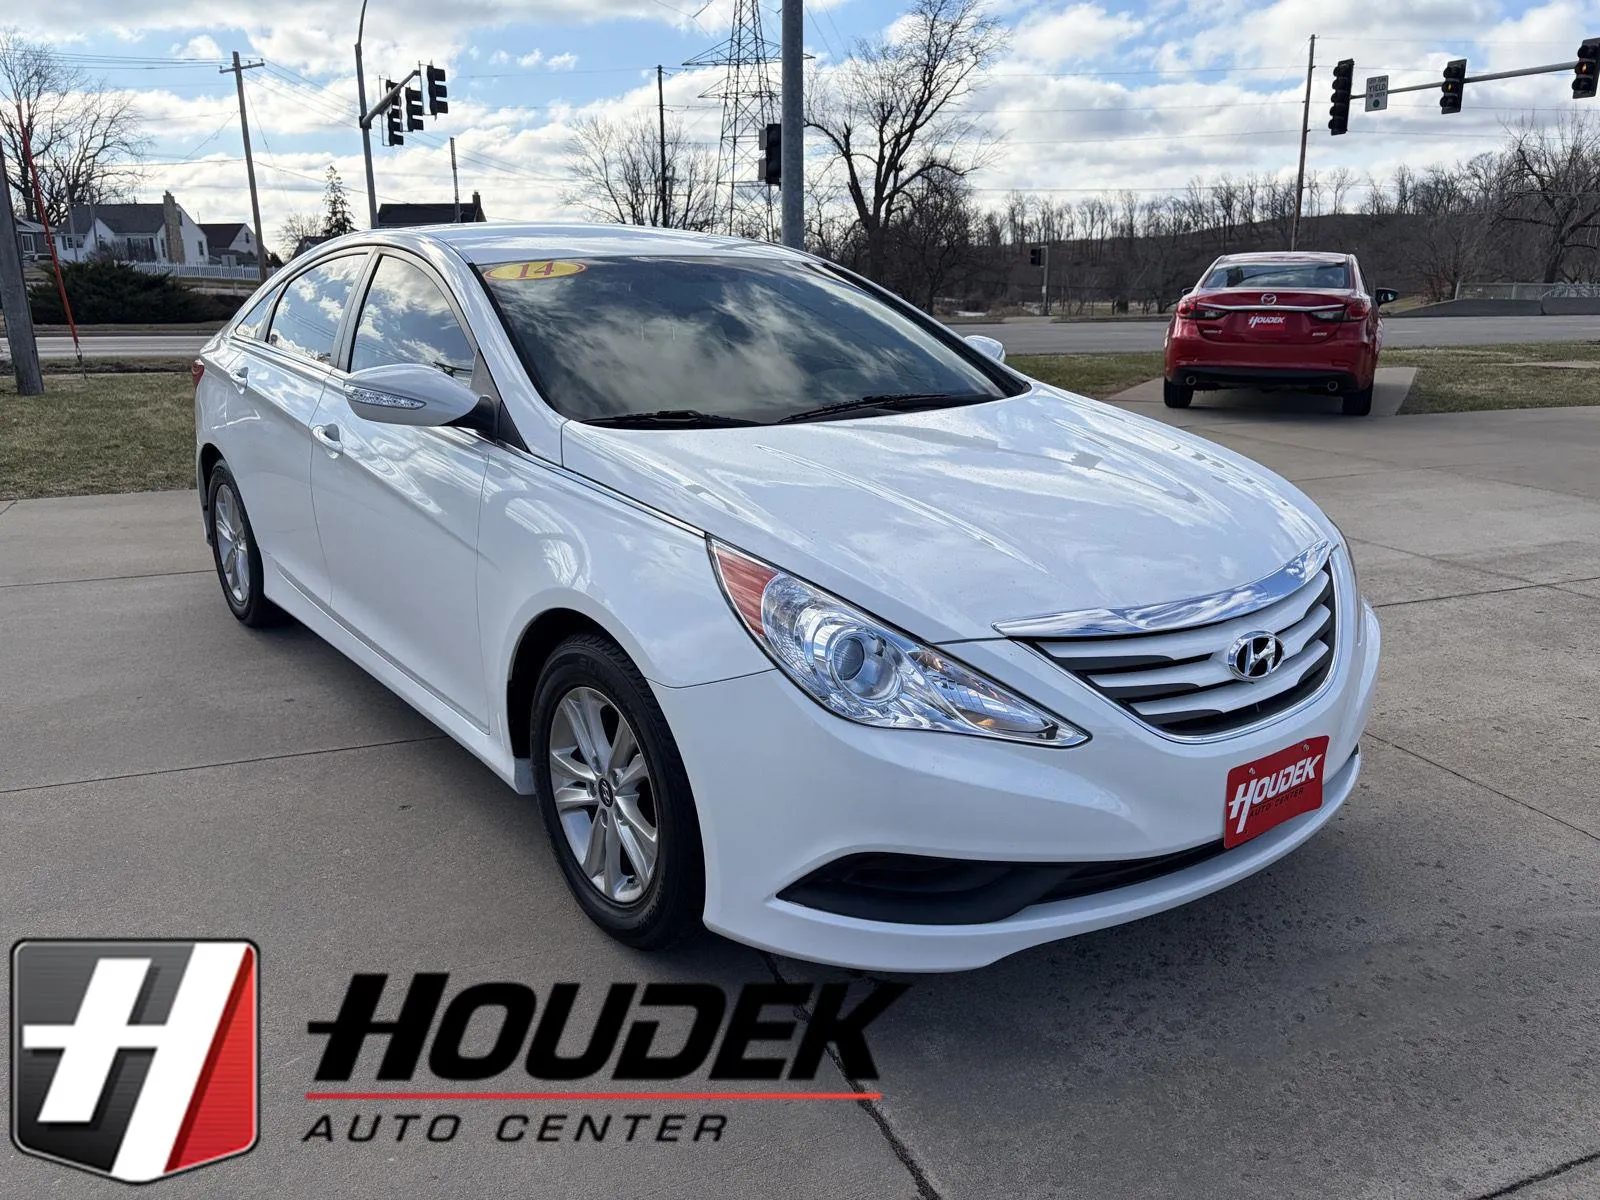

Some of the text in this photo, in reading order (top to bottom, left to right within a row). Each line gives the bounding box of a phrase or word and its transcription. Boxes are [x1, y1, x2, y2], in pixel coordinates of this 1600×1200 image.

[1368, 83, 1386, 92] YIELD
[516, 261, 554, 278] 14
[1248, 316, 1285, 329] HOUDEK
[1229, 754, 1323, 834] HOUDEK
[1250, 787, 1304, 817] AUTO CENTER
